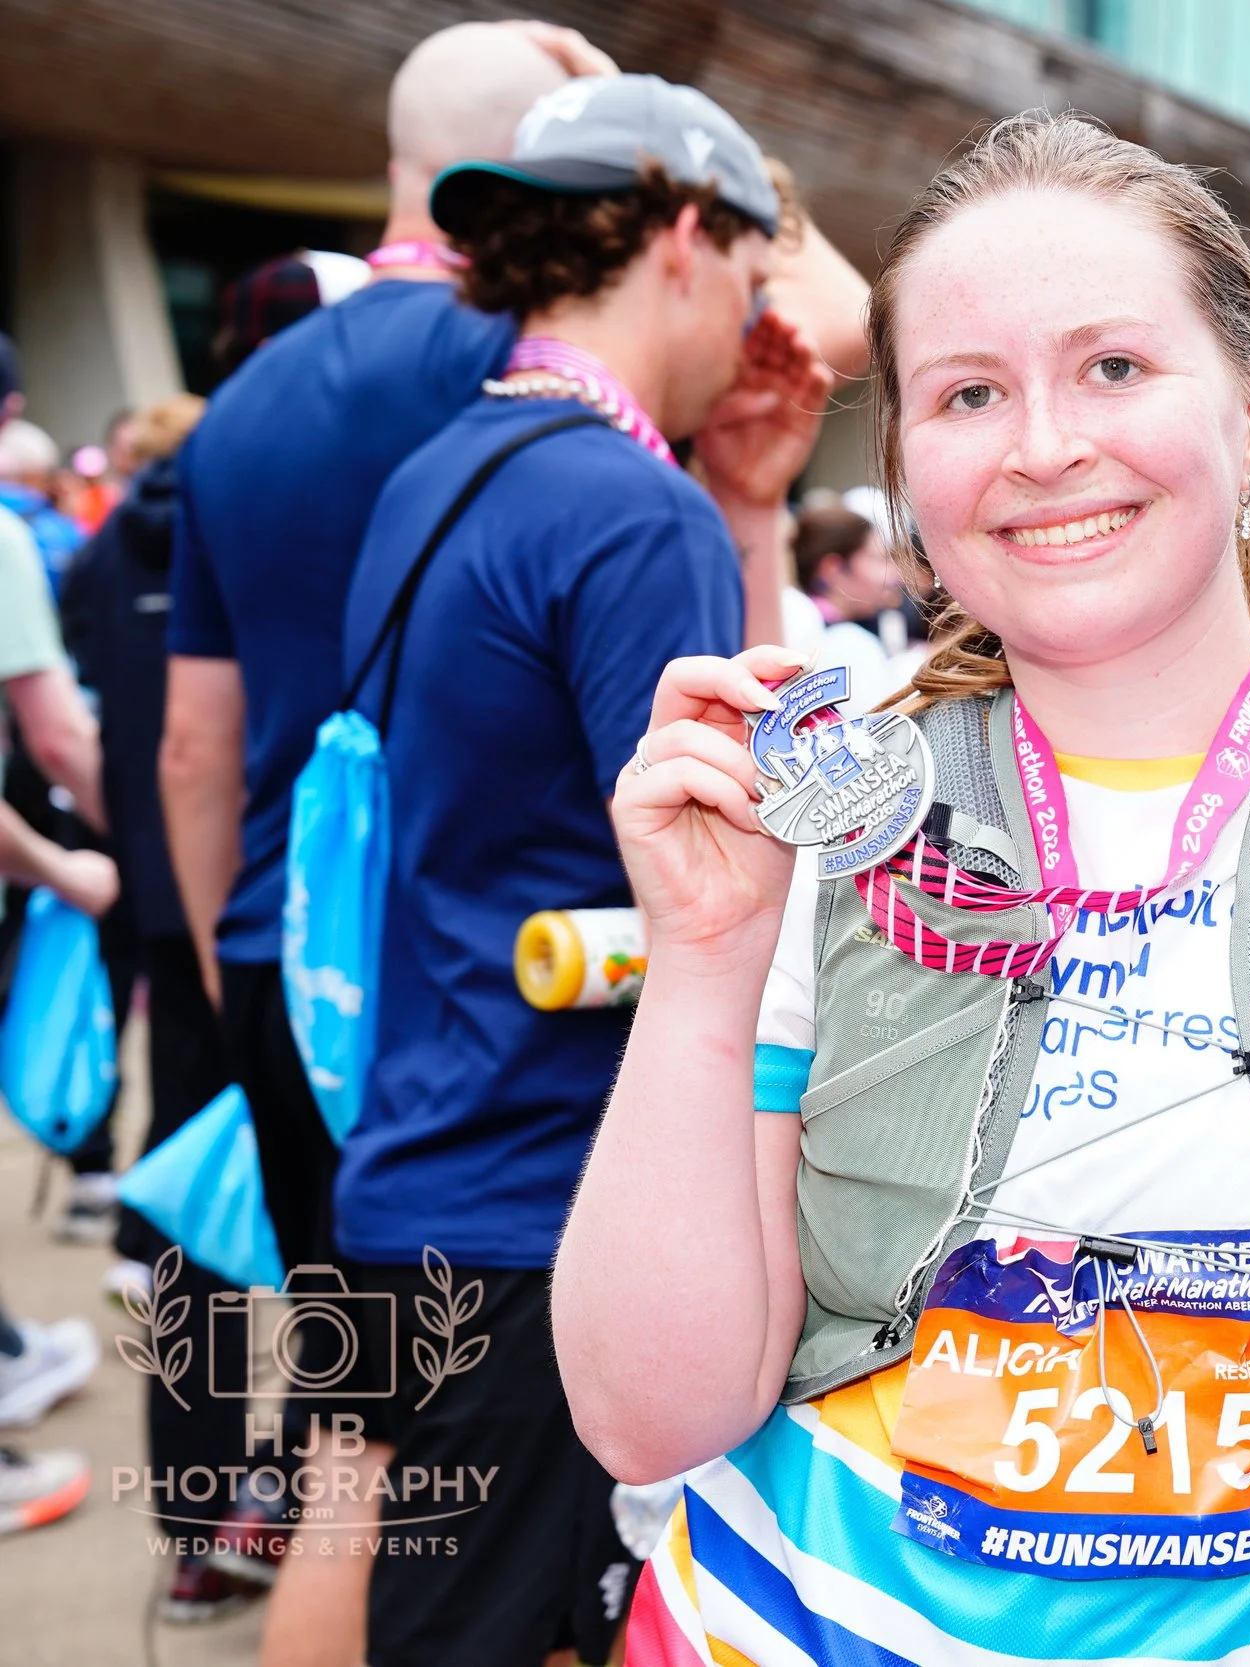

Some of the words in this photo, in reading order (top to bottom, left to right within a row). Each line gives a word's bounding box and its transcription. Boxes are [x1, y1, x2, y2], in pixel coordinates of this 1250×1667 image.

[780, 690, 824, 728] Abertawe
[809, 753, 908, 828] SWANSEA
[823, 786, 922, 873] #RUNSWANSEA
[860, 803, 895, 833] 2026
[1036, 806, 1061, 870] 2026
[1182, 792, 1224, 855] 2026
[1163, 1010, 1242, 1055] res
[1161, 1299, 1223, 1311] MARATHON
[922, 1329, 1080, 1379] ALICIA
